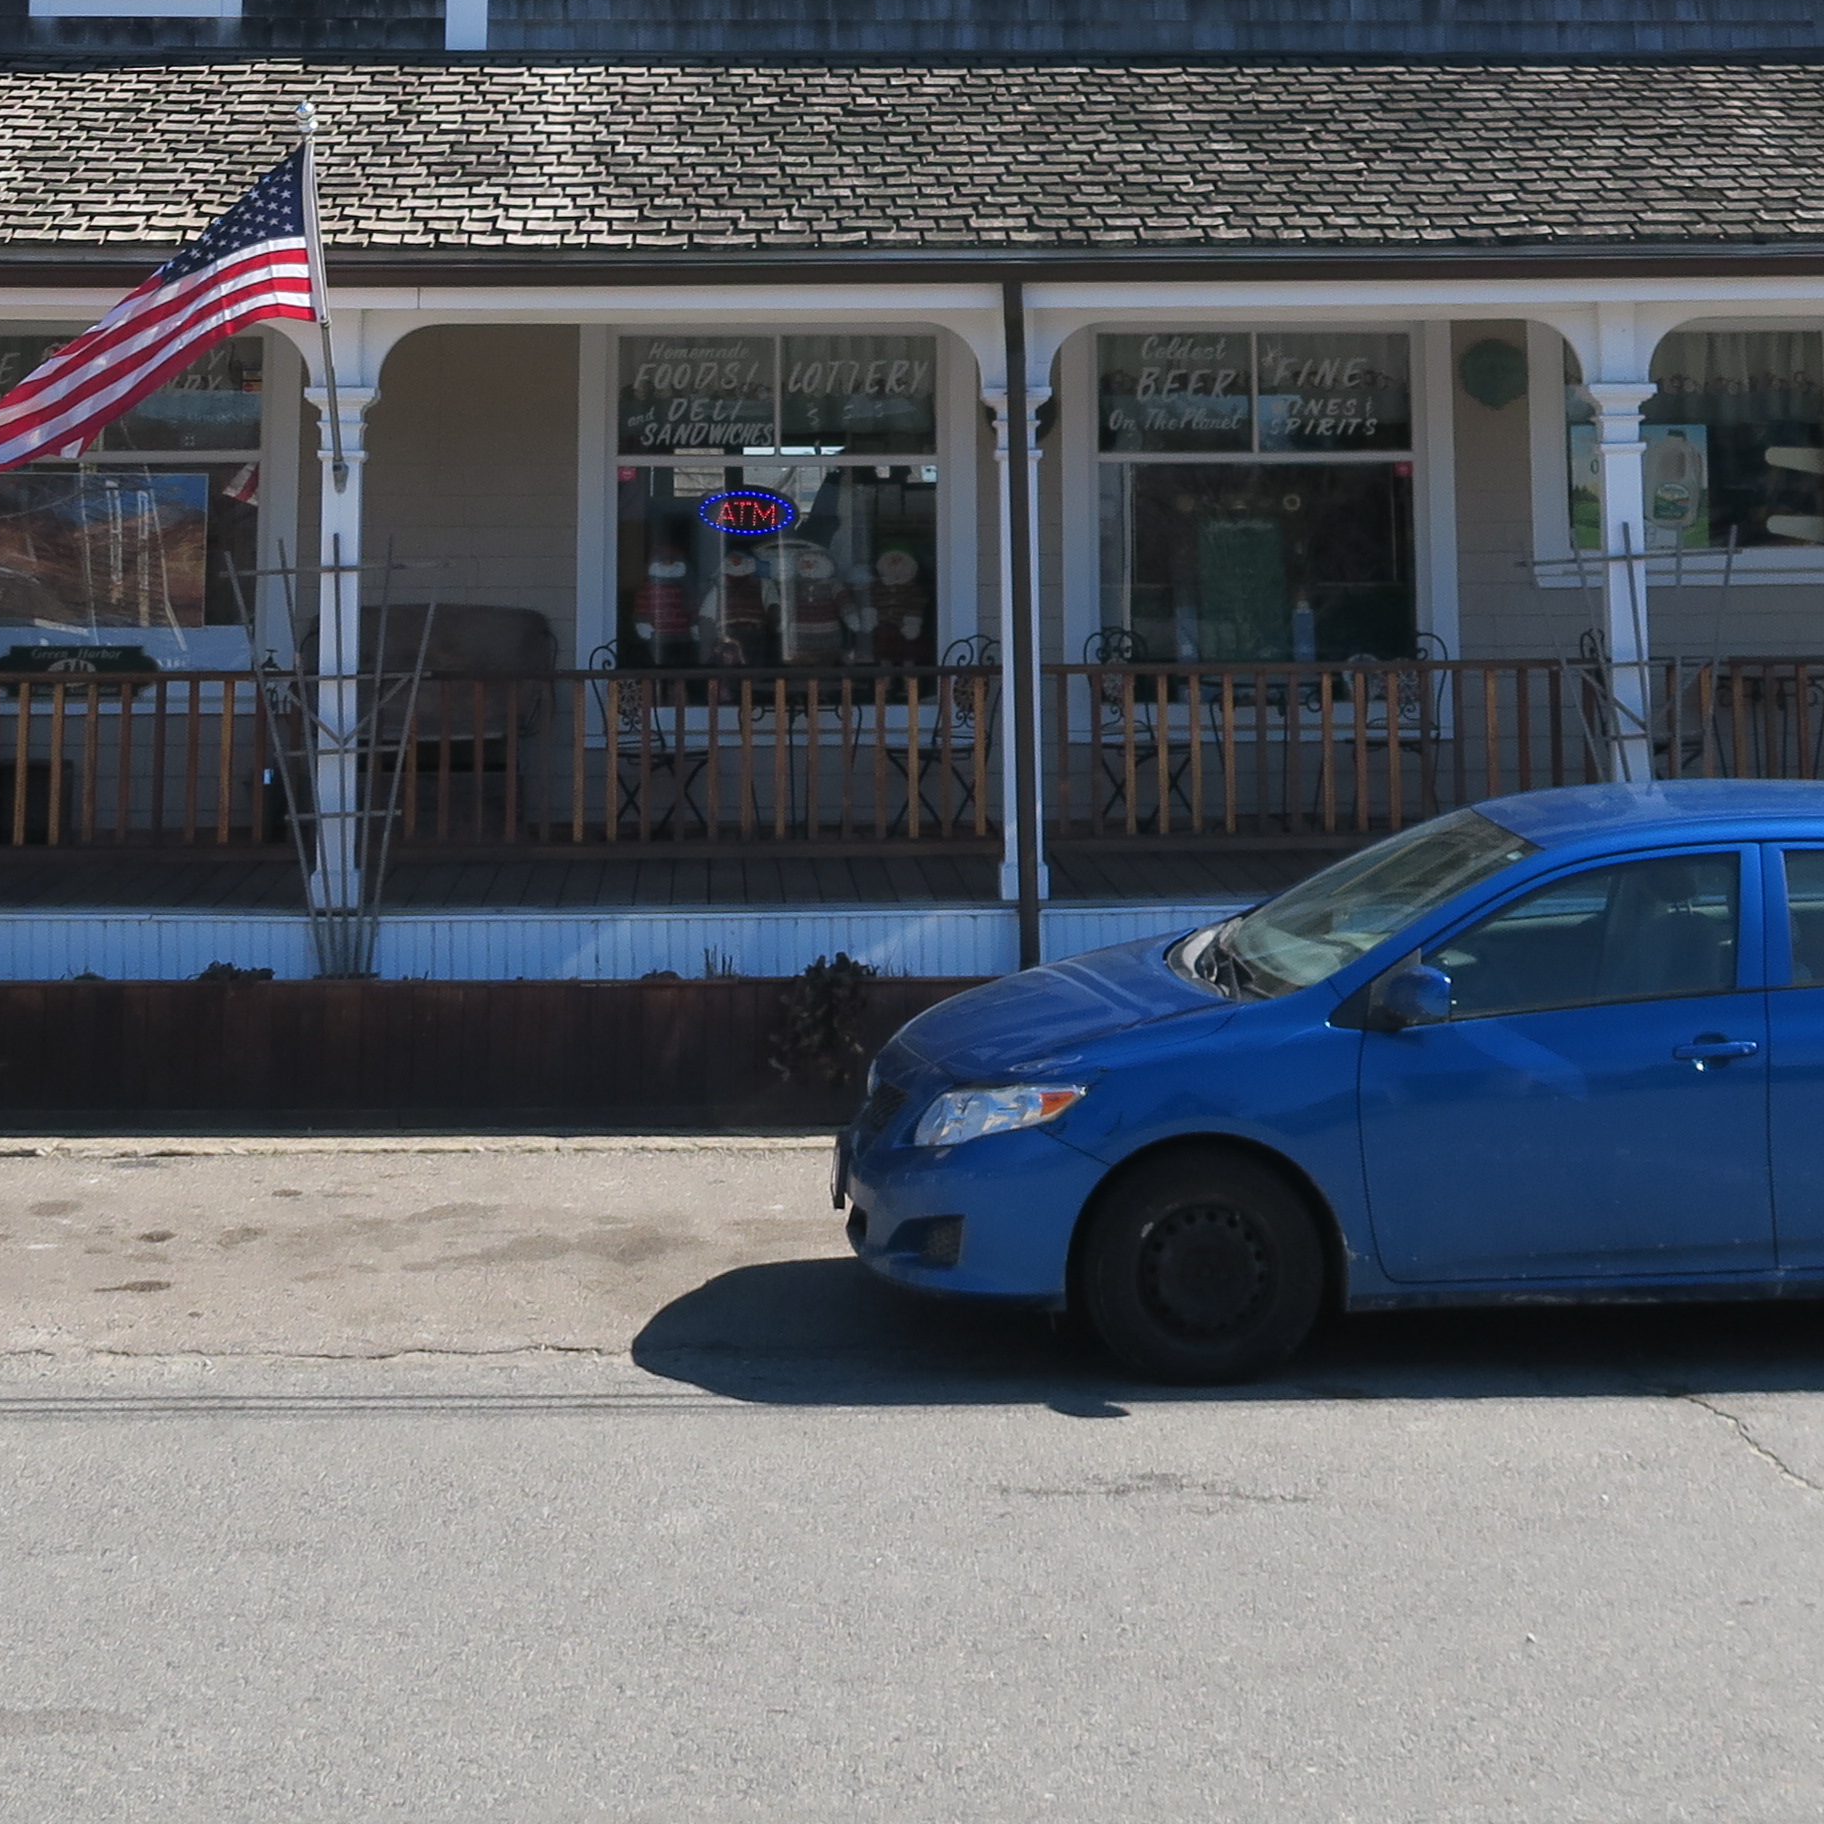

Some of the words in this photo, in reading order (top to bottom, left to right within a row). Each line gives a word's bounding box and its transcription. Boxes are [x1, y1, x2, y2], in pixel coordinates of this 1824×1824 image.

[648, 341, 750, 360] Homemade
[1142, 336, 1226, 361] Coldest
[634, 363, 758, 392] FOODS!
[788, 360, 928, 393] LOTTERY
[1136, 366, 1236, 402] BEER
[1275, 357, 1367, 387] FINE
[628, 407, 655, 426] and
[667, 398, 744, 422] DELI
[1109, 408, 1136, 430] On
[1145, 407, 1177, 430] The
[1179, 407, 1243, 430] Planet
[641, 422, 774, 447] SANDWICHES
[1270, 418, 1378, 436] SPIRITS
[715, 501, 777, 527] ATM
[31, 648, 69, 660] Green
[77, 648, 123, 660] Harbor
